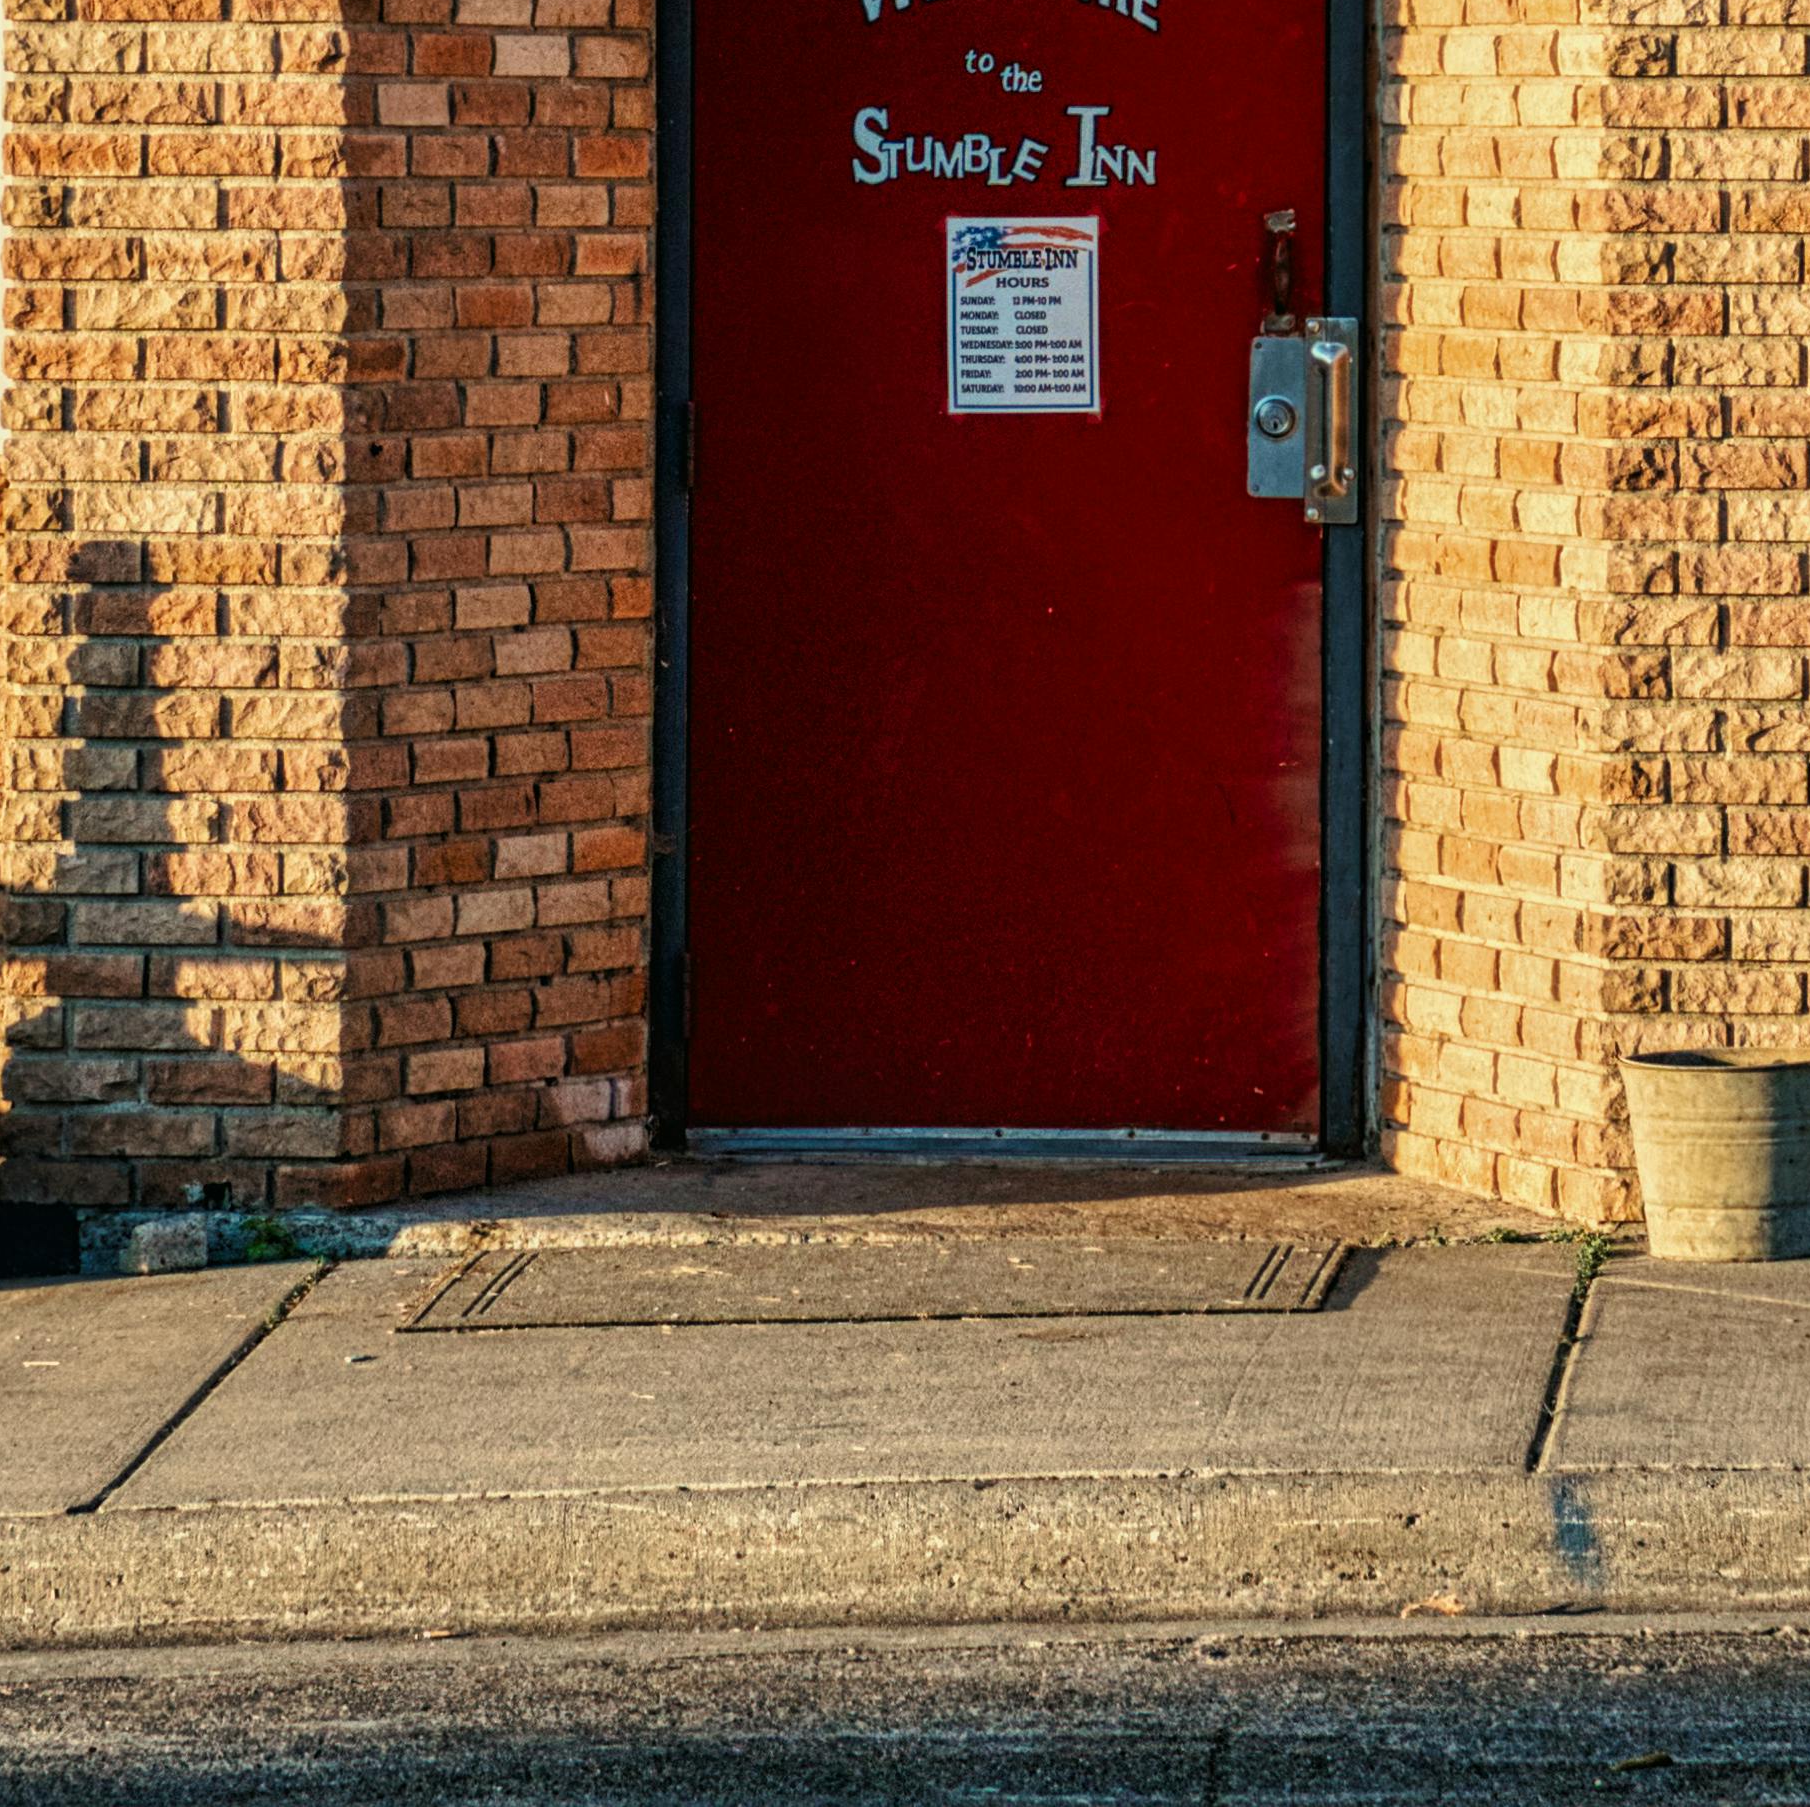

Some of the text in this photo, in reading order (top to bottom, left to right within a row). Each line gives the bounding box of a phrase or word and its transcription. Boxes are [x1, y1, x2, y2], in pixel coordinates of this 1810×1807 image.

[964, 48, 1044, 93] to the
[852, 104, 1158, 188] STUMBLE INN
[966, 247, 1078, 270] STUMBLE INN
[996, 277, 1049, 288] HOURS
[960, 297, 995, 305] SUNDAY:
[1049, 297, 1061, 305] PM
[960, 311, 1046, 320] MONDAY: CLOSED
[960, 326, 1048, 335] TUESDAY: CLOSED
[960, 341, 1013, 349] WEDNESDAY:
[1069, 341, 1082, 349] AM
[960, 355, 1005, 364] THURSDAY:
[1014, 355, 1032, 364] 4:00
[1071, 355, 1084, 364] AM
[960, 370, 992, 378] FRIDAY:
[1015, 370, 1033, 378] 2:00
[1071, 370, 1084, 378] AM
[961, 384, 1004, 393] SATURDAY:
[1073, 384, 1086, 393] AM
